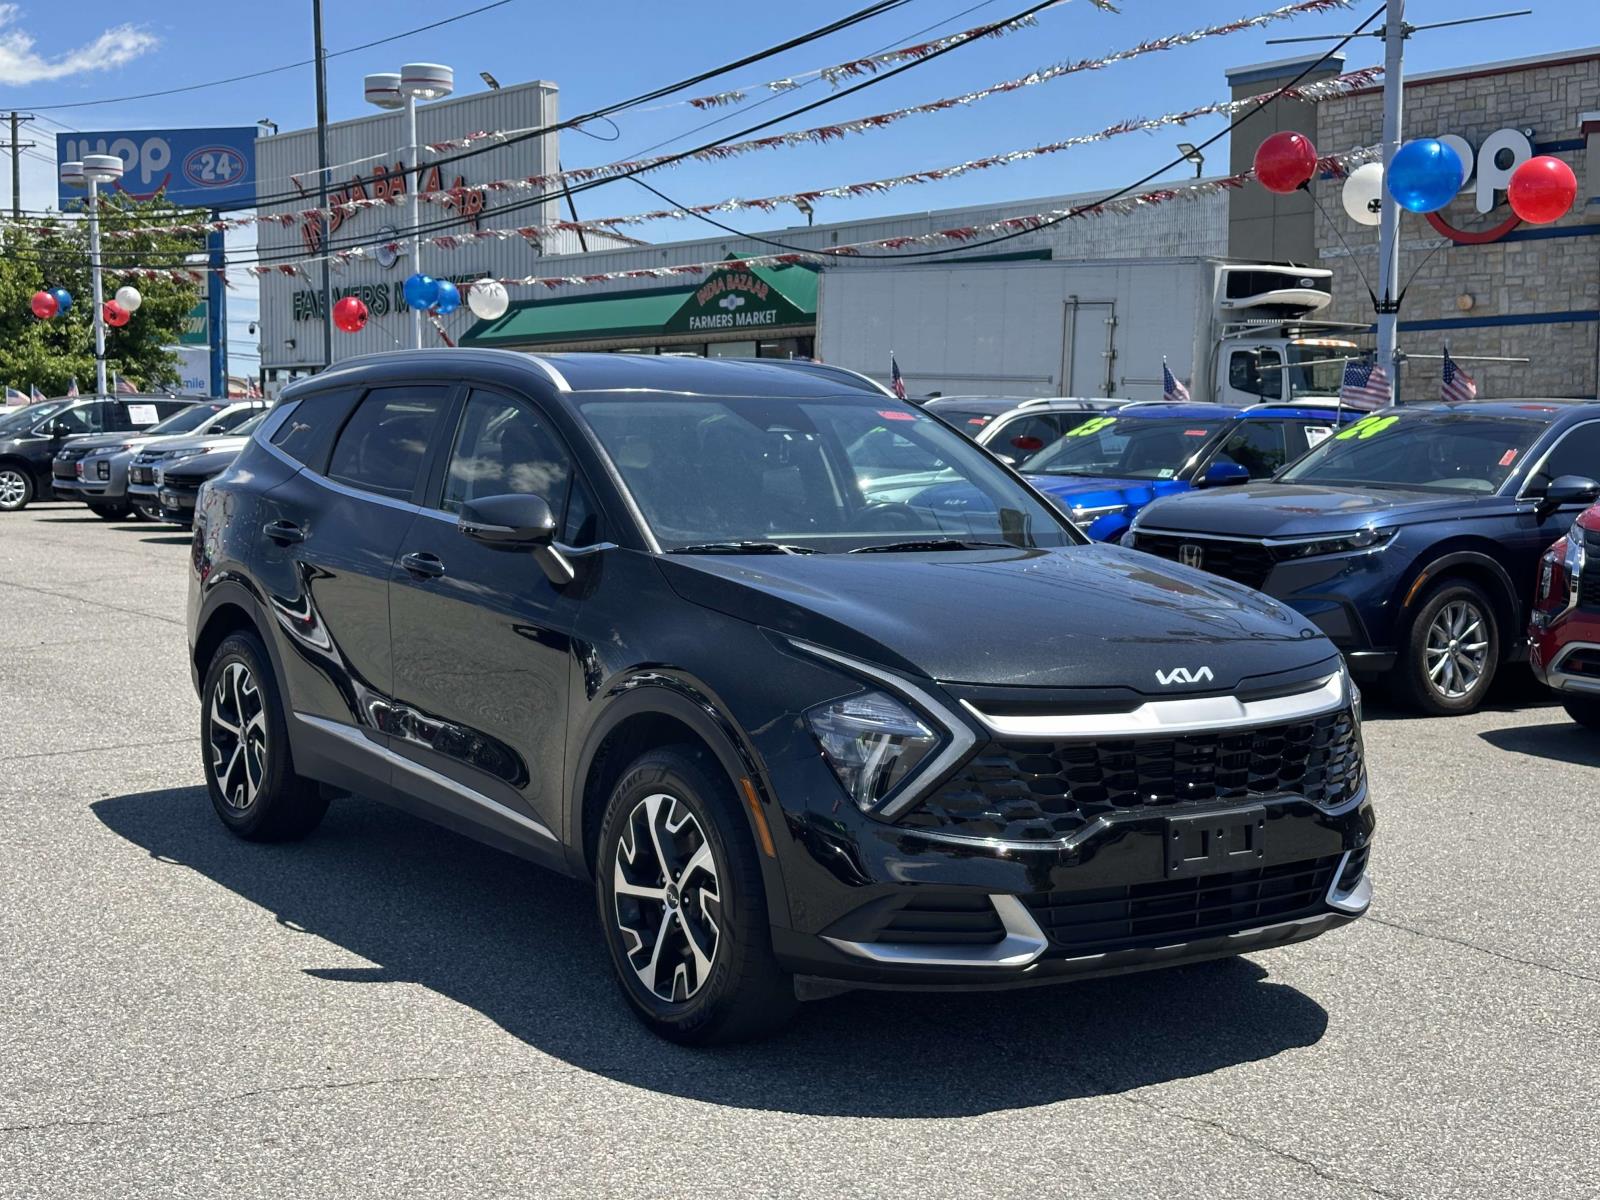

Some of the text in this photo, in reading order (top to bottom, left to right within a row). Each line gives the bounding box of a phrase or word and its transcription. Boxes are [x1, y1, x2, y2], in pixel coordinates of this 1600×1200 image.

[201, 152, 231, 180] 24
[372, 161, 486, 230] BAAAR
[697, 274, 769, 306] INDIA BAZAAR
[690, 310, 777, 329] FARMERS MARKET
